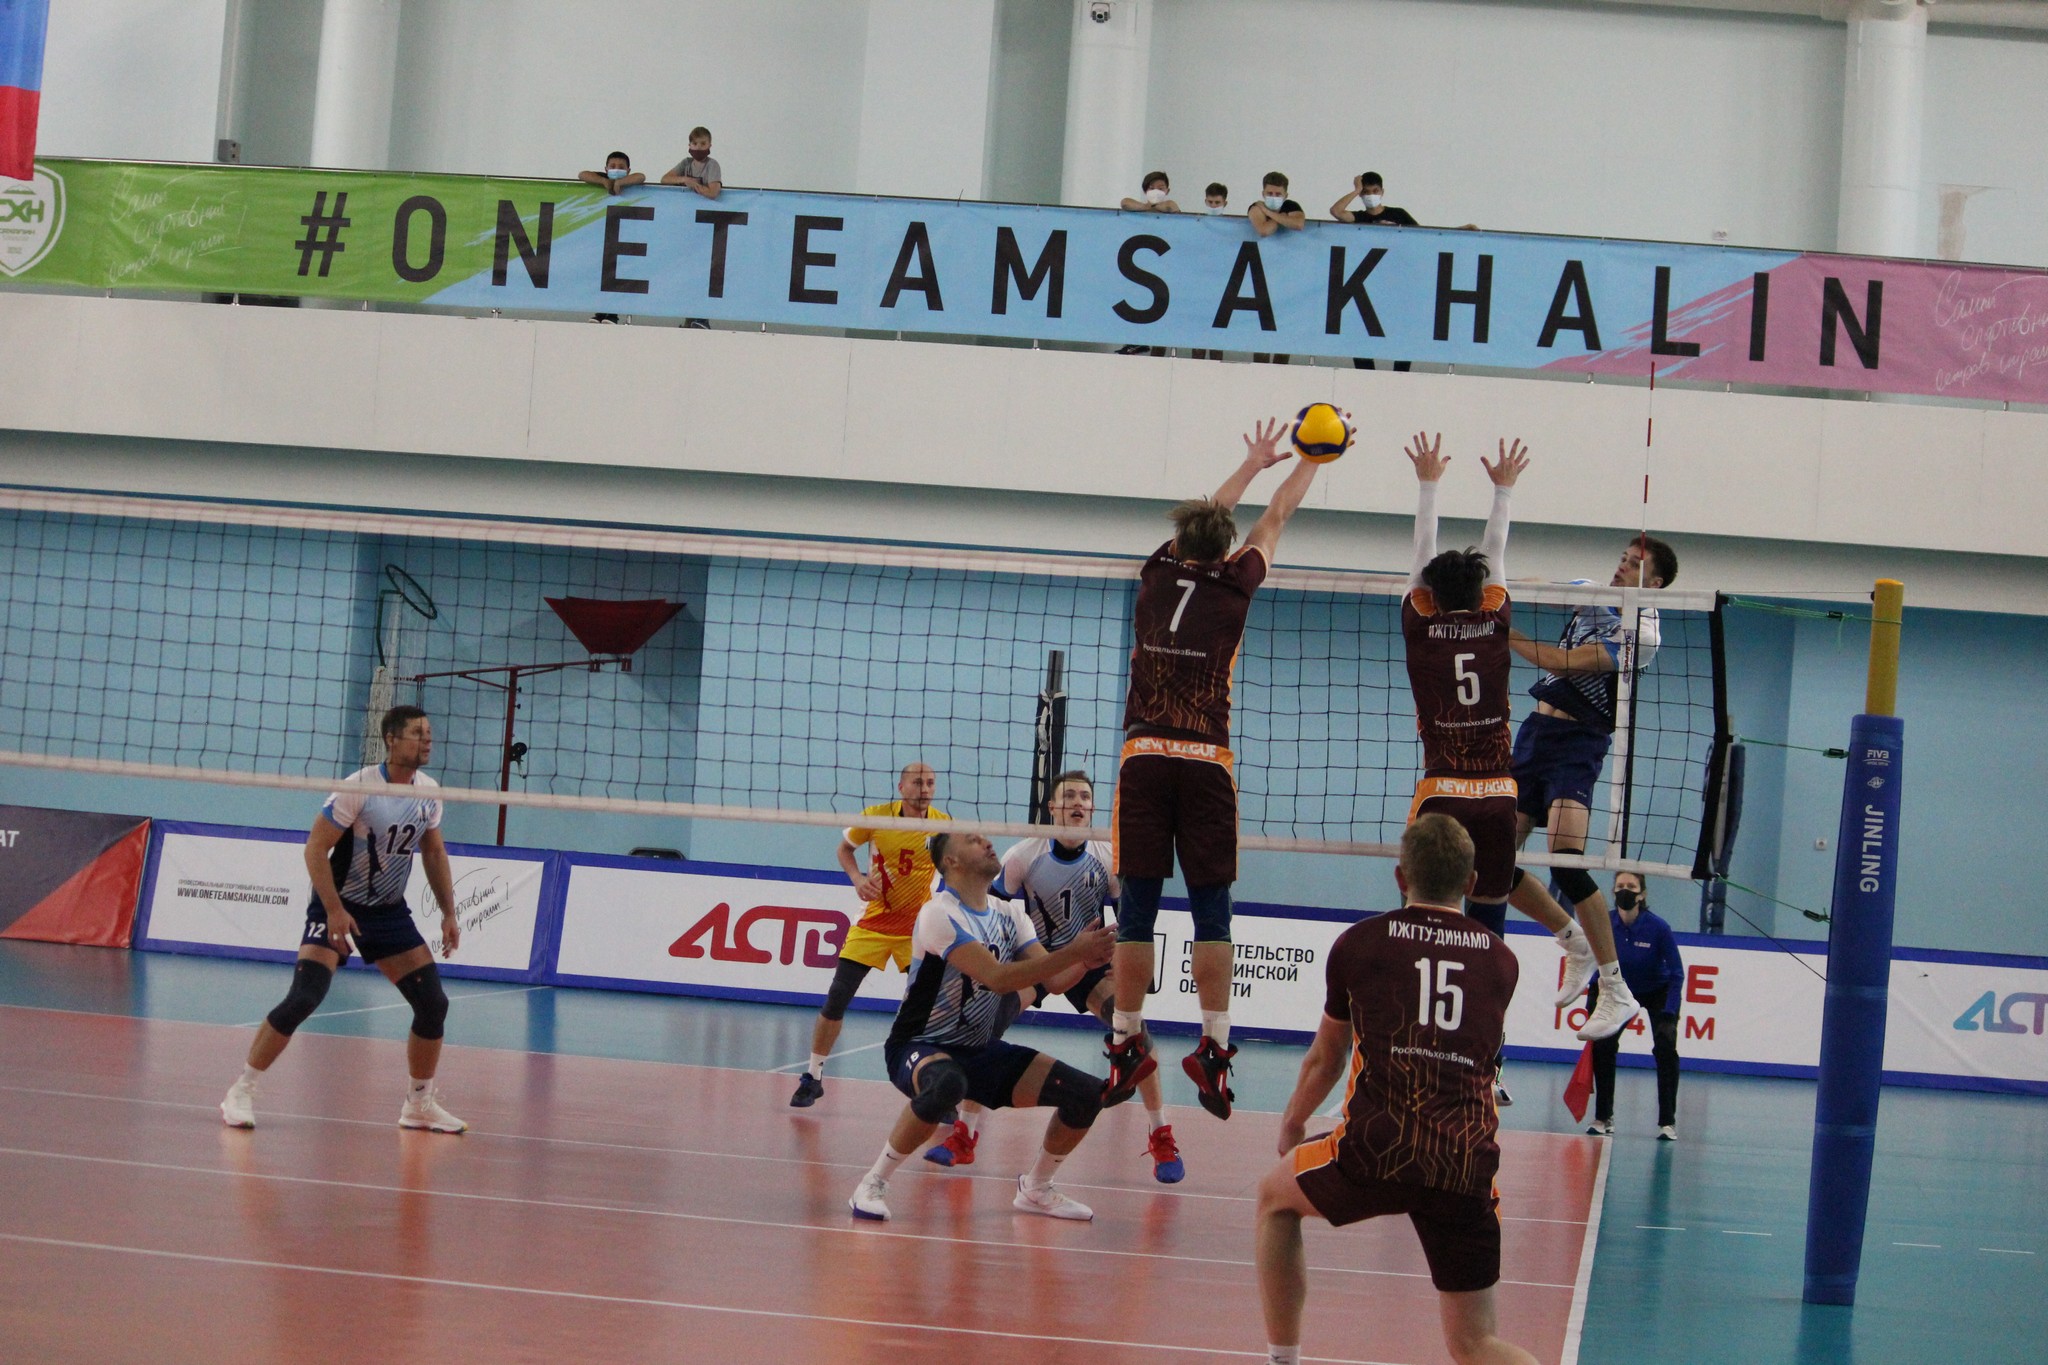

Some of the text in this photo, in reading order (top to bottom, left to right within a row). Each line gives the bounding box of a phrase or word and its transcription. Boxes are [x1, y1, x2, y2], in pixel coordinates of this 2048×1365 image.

[294, 190, 1884, 370] #ONETEAMSAKHALIN
[1169, 579, 1196, 632] 7
[1428, 620, 1495, 640] ИЖГТУ-ДИНАМО
[1454, 653, 1480, 706] 5
[1134, 737, 1217, 758] NEW LEAGUE
[1435, 778, 1514, 795] NEW LEAGUE
[386, 823, 417, 856] 12
[1859, 804, 1885, 893] JINLING
[898, 848, 914, 877] 5
[177, 888, 289, 906] WWW.ONETEAMSAKHALIN.COM
[1059, 888, 1072, 922] 1
[308, 922, 327, 938] 12
[1388, 920, 1490, 950] ИЖГТУ-ДИНАМО
[1183, 940, 1315, 964] ПТЕЛЬСТВО
[1181, 960, 1299, 982] СИНСКОЙ
[1414, 957, 1465, 1031] 15
[905, 1051, 920, 1070] 18
[1391, 1045, 1475, 1067] РоссельхозБанк
